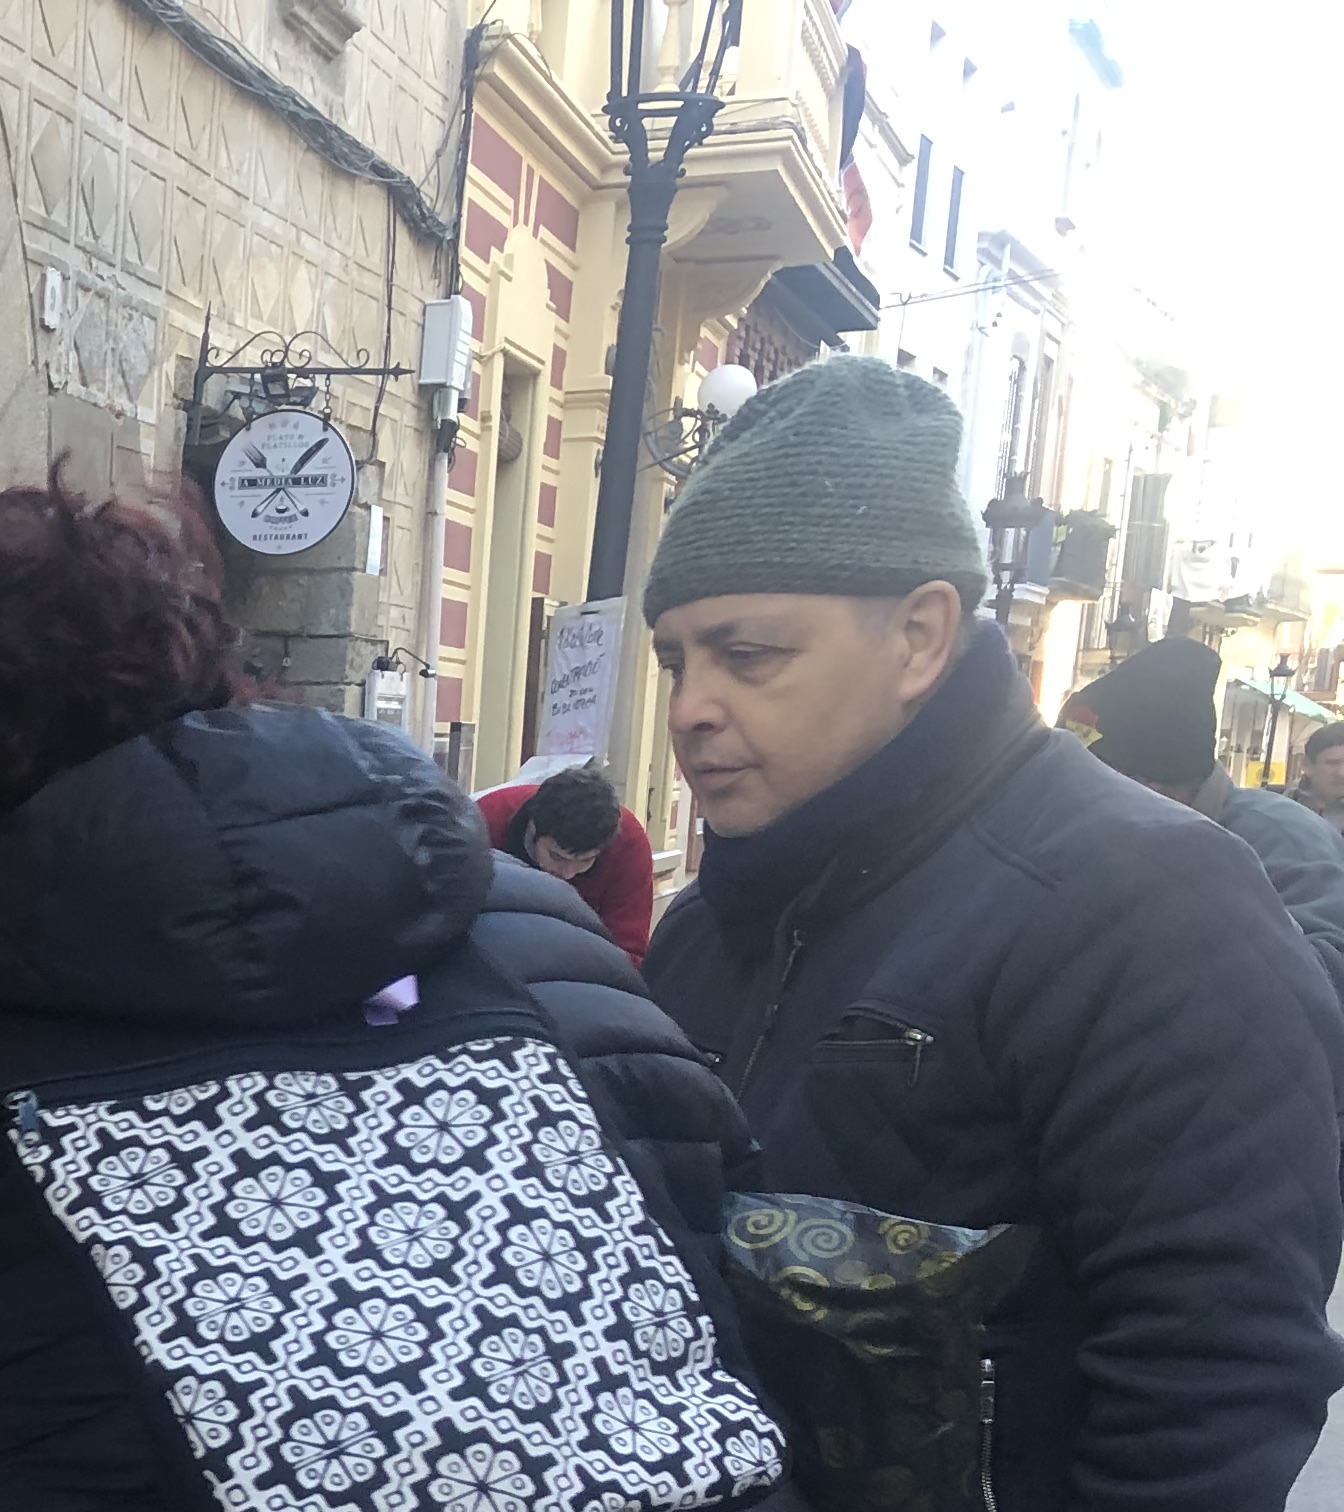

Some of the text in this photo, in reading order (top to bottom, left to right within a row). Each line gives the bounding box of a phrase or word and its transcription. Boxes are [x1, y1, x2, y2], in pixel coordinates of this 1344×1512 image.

[241, 475, 324, 487] A MEDIA LUZ
[252, 532, 309, 542] RESTAURANT
